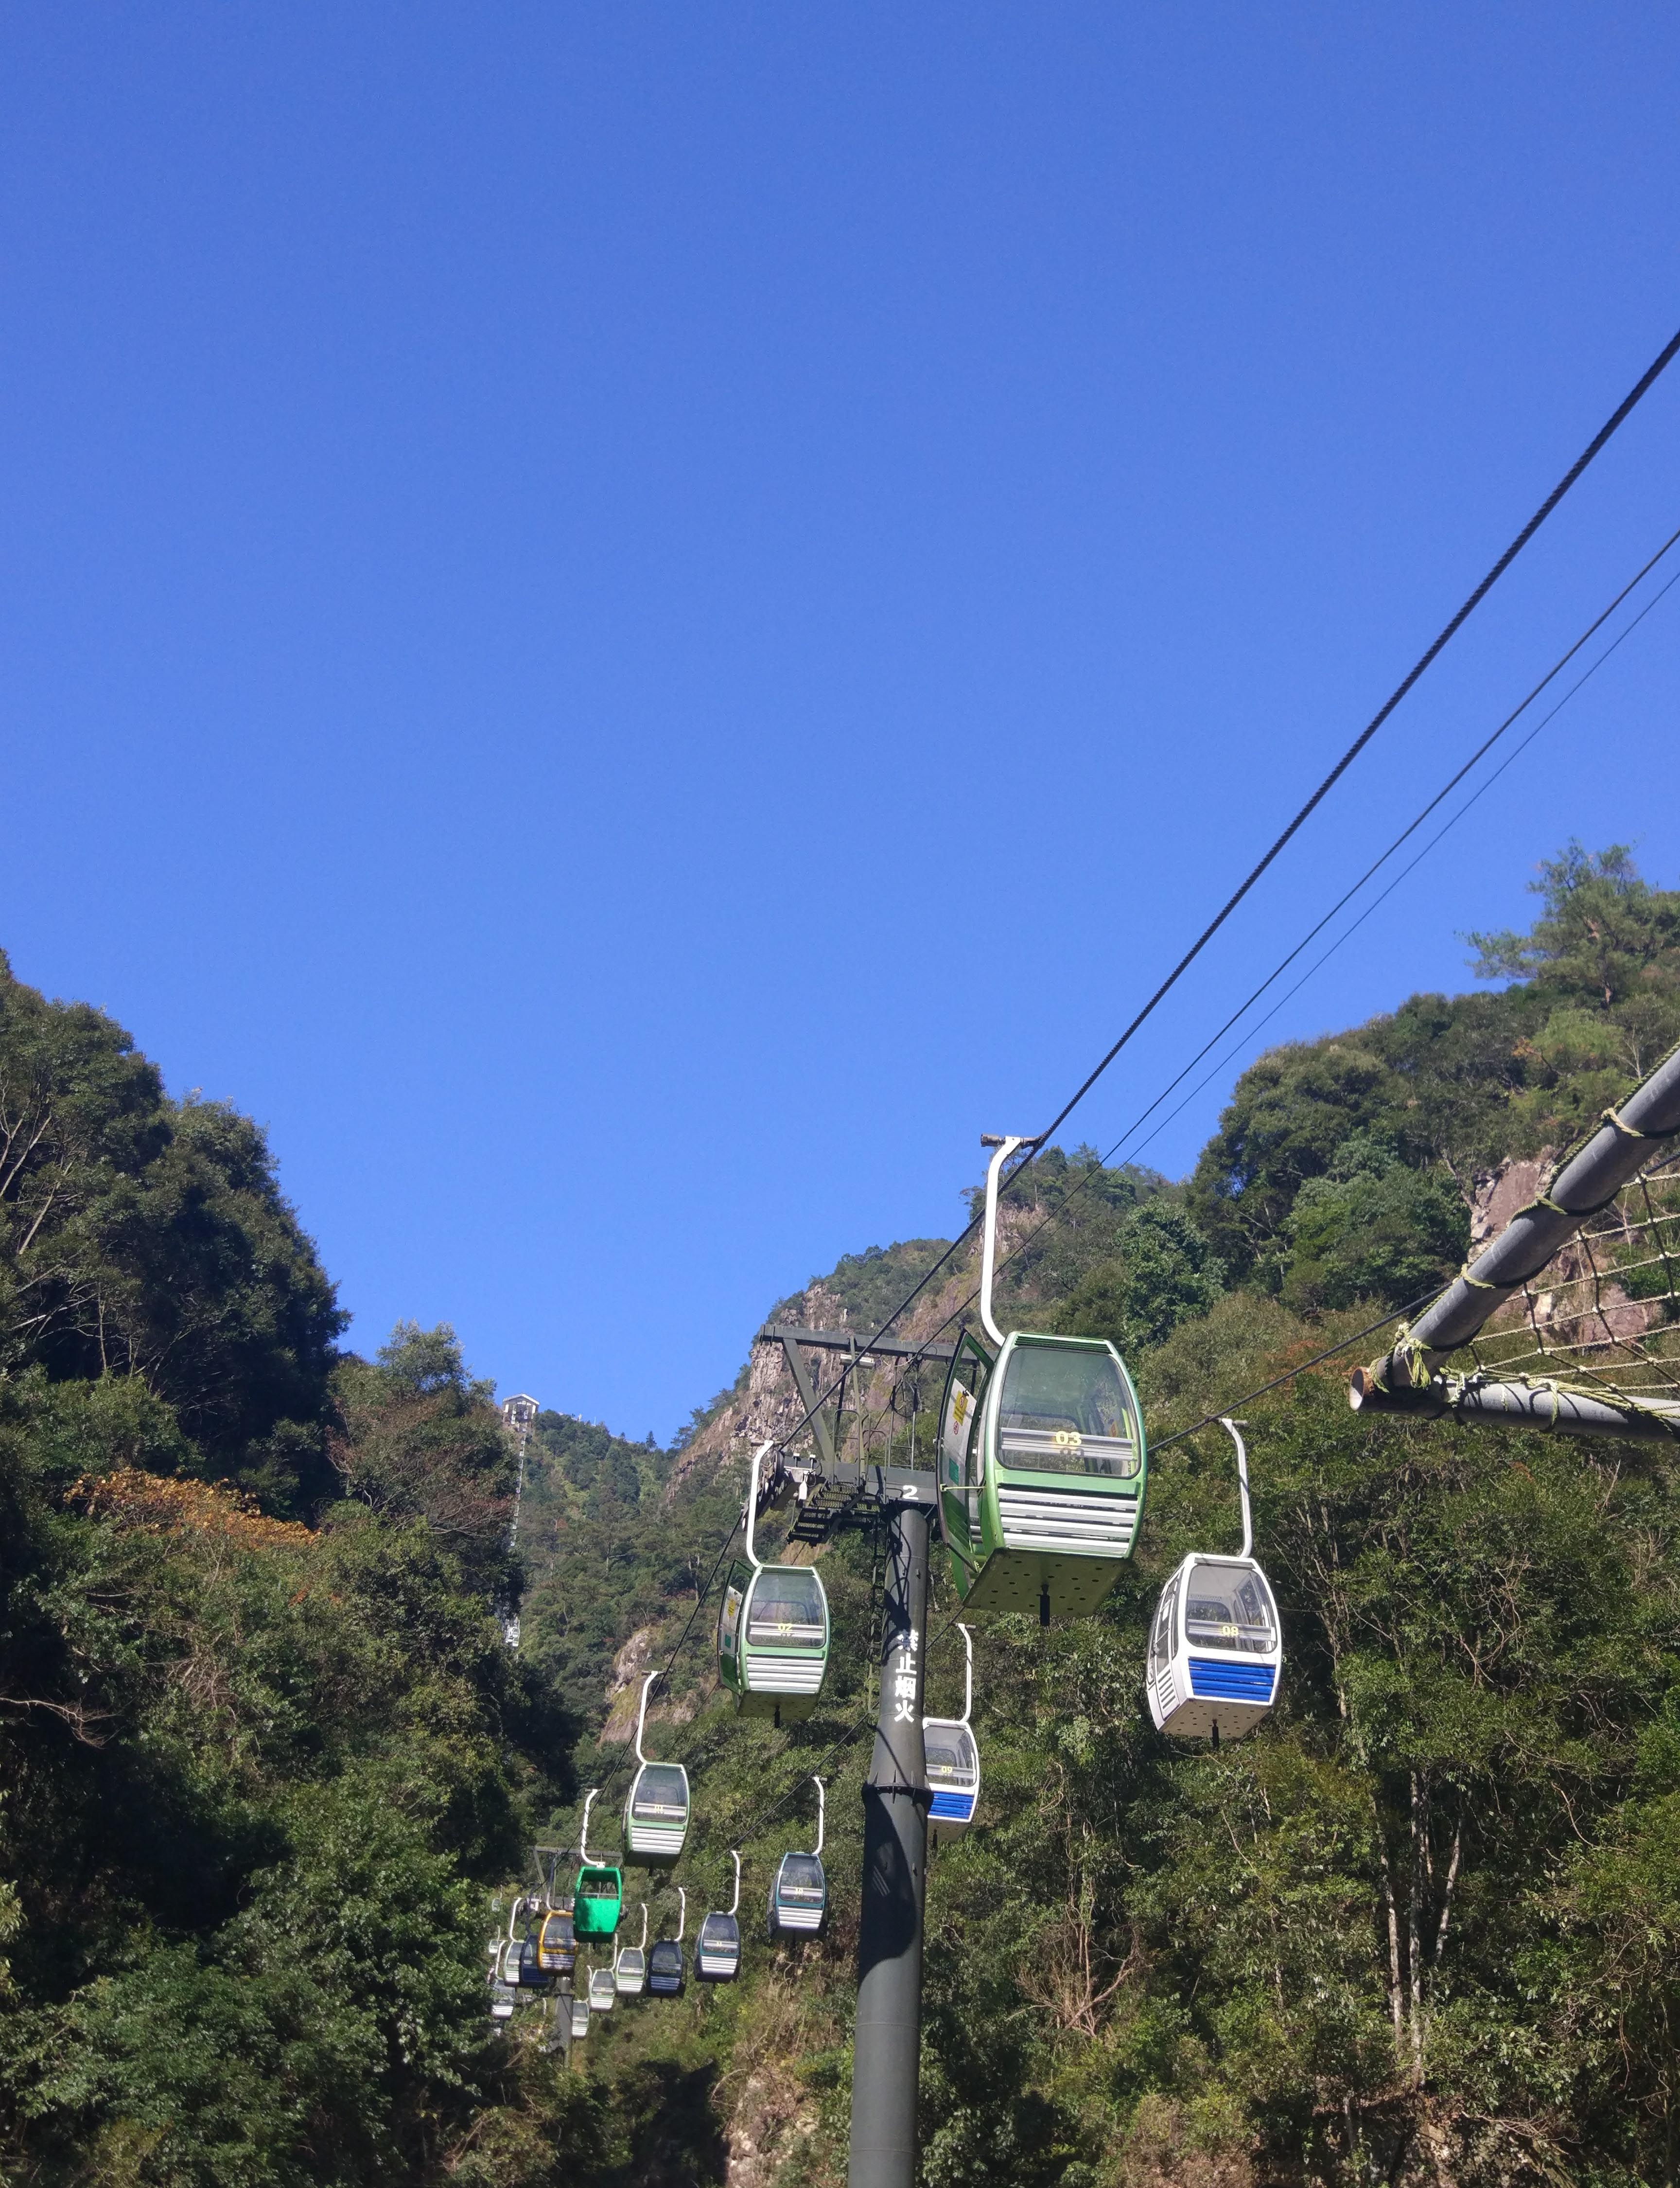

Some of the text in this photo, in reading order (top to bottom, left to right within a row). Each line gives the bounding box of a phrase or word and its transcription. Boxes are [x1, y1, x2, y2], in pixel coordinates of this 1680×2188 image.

[1056, 1431, 1082, 1446] 03
[903, 1485, 919, 1500] 2
[778, 1623, 793, 1632] 02
[1223, 1626, 1239, 1636] 08
[894, 1629, 919, 1723] 禁止烟火
